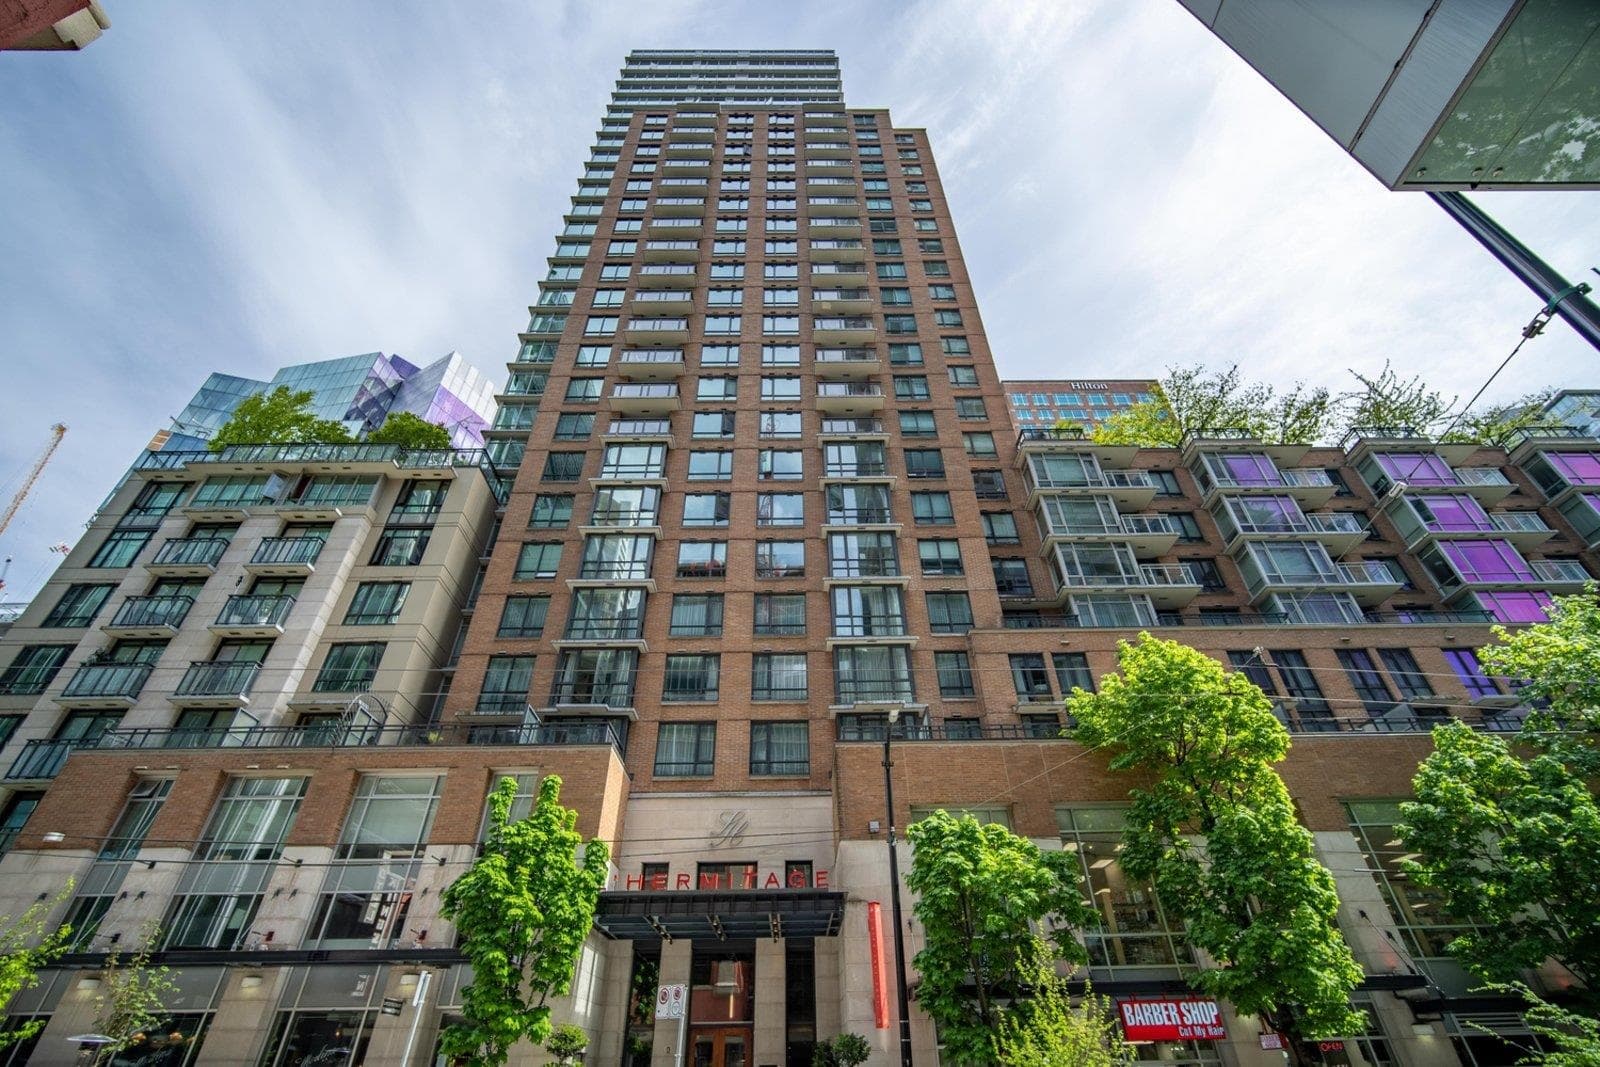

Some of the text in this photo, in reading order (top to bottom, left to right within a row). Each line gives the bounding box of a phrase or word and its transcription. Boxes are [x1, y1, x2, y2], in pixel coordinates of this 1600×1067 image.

[1069, 381, 1109, 390] Hilton
[598, 868, 829, 891] 'HERMITAGE
[1122, 1001, 1218, 1026] BARBER SHOP
[1178, 1025, 1225, 1038] Cut My Hair
[1319, 1041, 1345, 1052] OPEN
